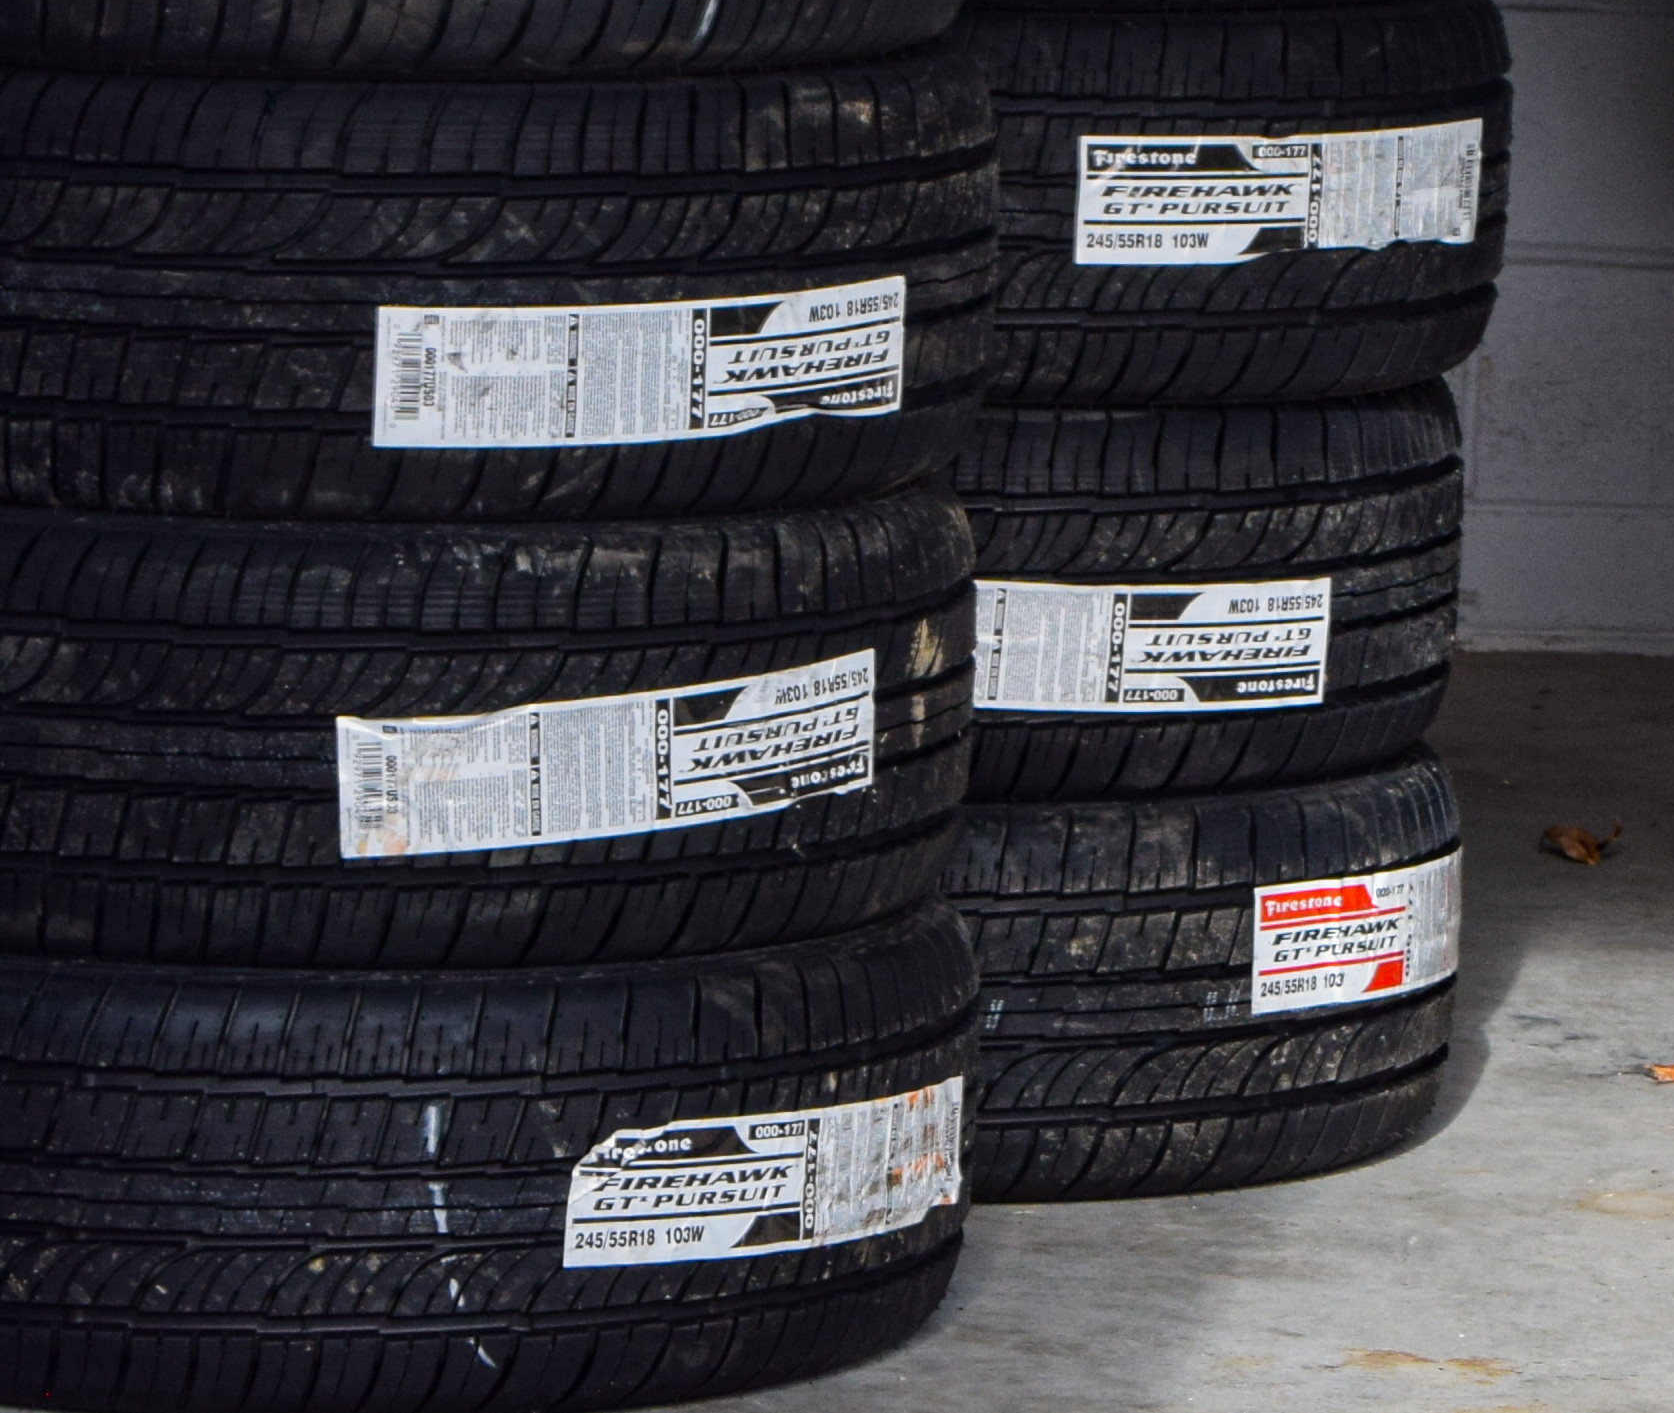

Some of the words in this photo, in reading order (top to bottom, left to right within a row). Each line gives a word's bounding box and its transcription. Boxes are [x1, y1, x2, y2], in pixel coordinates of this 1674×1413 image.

[1091, 149, 1197, 167] Firestone
[1258, 145, 1307, 158] 000-177
[1101, 185, 1296, 197] FIREHAWK
[1160, 202, 1289, 215] PURSUIT
[1086, 234, 1163, 249] 245/55R18
[1172, 234, 1209, 248] 103W
[809, 303, 841, 322] 103W
[846, 291, 900, 315] 245/55R18
[728, 339, 851, 366] PURSUIT
[423, 347, 437, 408] 000177US03
[691, 320, 704, 418] 000-177
[723, 348, 889, 384] FIREHAWK
[819, 380, 895, 408] Firestone
[1228, 599, 1259, 613] 103W
[1268, 594, 1323, 610] 245/55R18
[1107, 603, 1125, 691] 000-177
[1146, 630, 1270, 646] PURSUIT
[1141, 646, 1311, 662] FIREHAWK
[813, 668, 869, 698] 245/55R18
[1236, 675, 1315, 693] Firestone
[1125, 690, 1178, 700] 000-177
[692, 717, 818, 753] PURSUIT
[657, 709, 671, 808] 000-177
[688, 724, 859, 773] FIREHAWK
[790, 757, 865, 790] Frestone
[676, 795, 732, 815] 000-177
[1265, 896, 1343, 915] Firestone
[1272, 918, 1400, 946] FIREHAWK
[1315, 935, 1397, 956] PURSUIT
[1260, 976, 1317, 996] 245/55R18
[1324, 973, 1345, 987] 103
[754, 1122, 803, 1138] 000-177
[594, 1165, 793, 1192] FIREHAWK
[802, 1130, 818, 1229] 000-177
[652, 1184, 785, 1208] PURSUIT
[574, 1230, 656, 1249] 245/55R18
[665, 1225, 705, 1245] 103W
